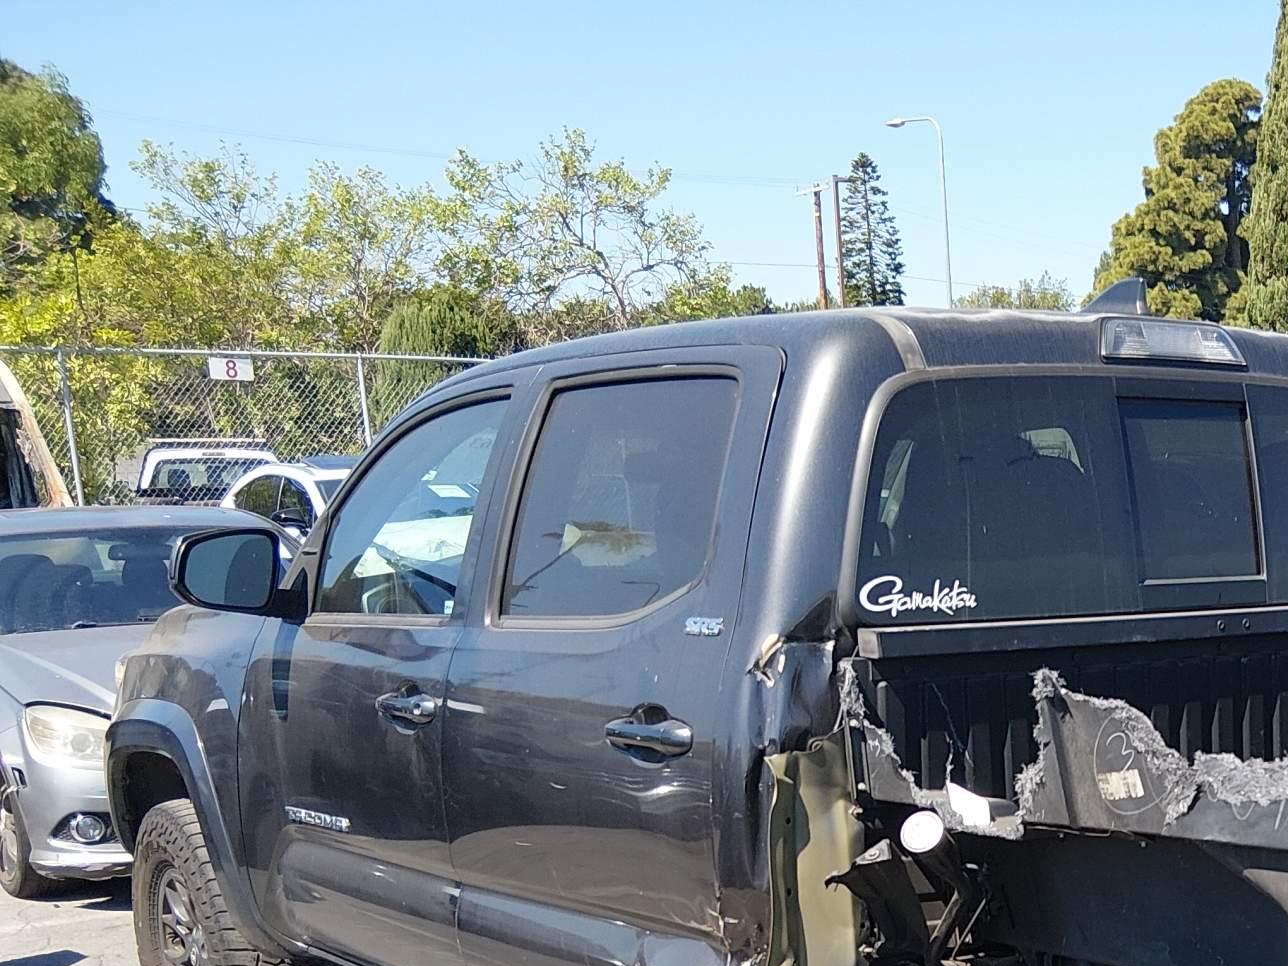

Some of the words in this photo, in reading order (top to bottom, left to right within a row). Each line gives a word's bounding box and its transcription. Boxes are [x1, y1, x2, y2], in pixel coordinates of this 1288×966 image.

[225, 360, 238, 378] 8
[859, 575, 978, 617] Gamakatsu
[284, 806, 352, 832] TACOMA
